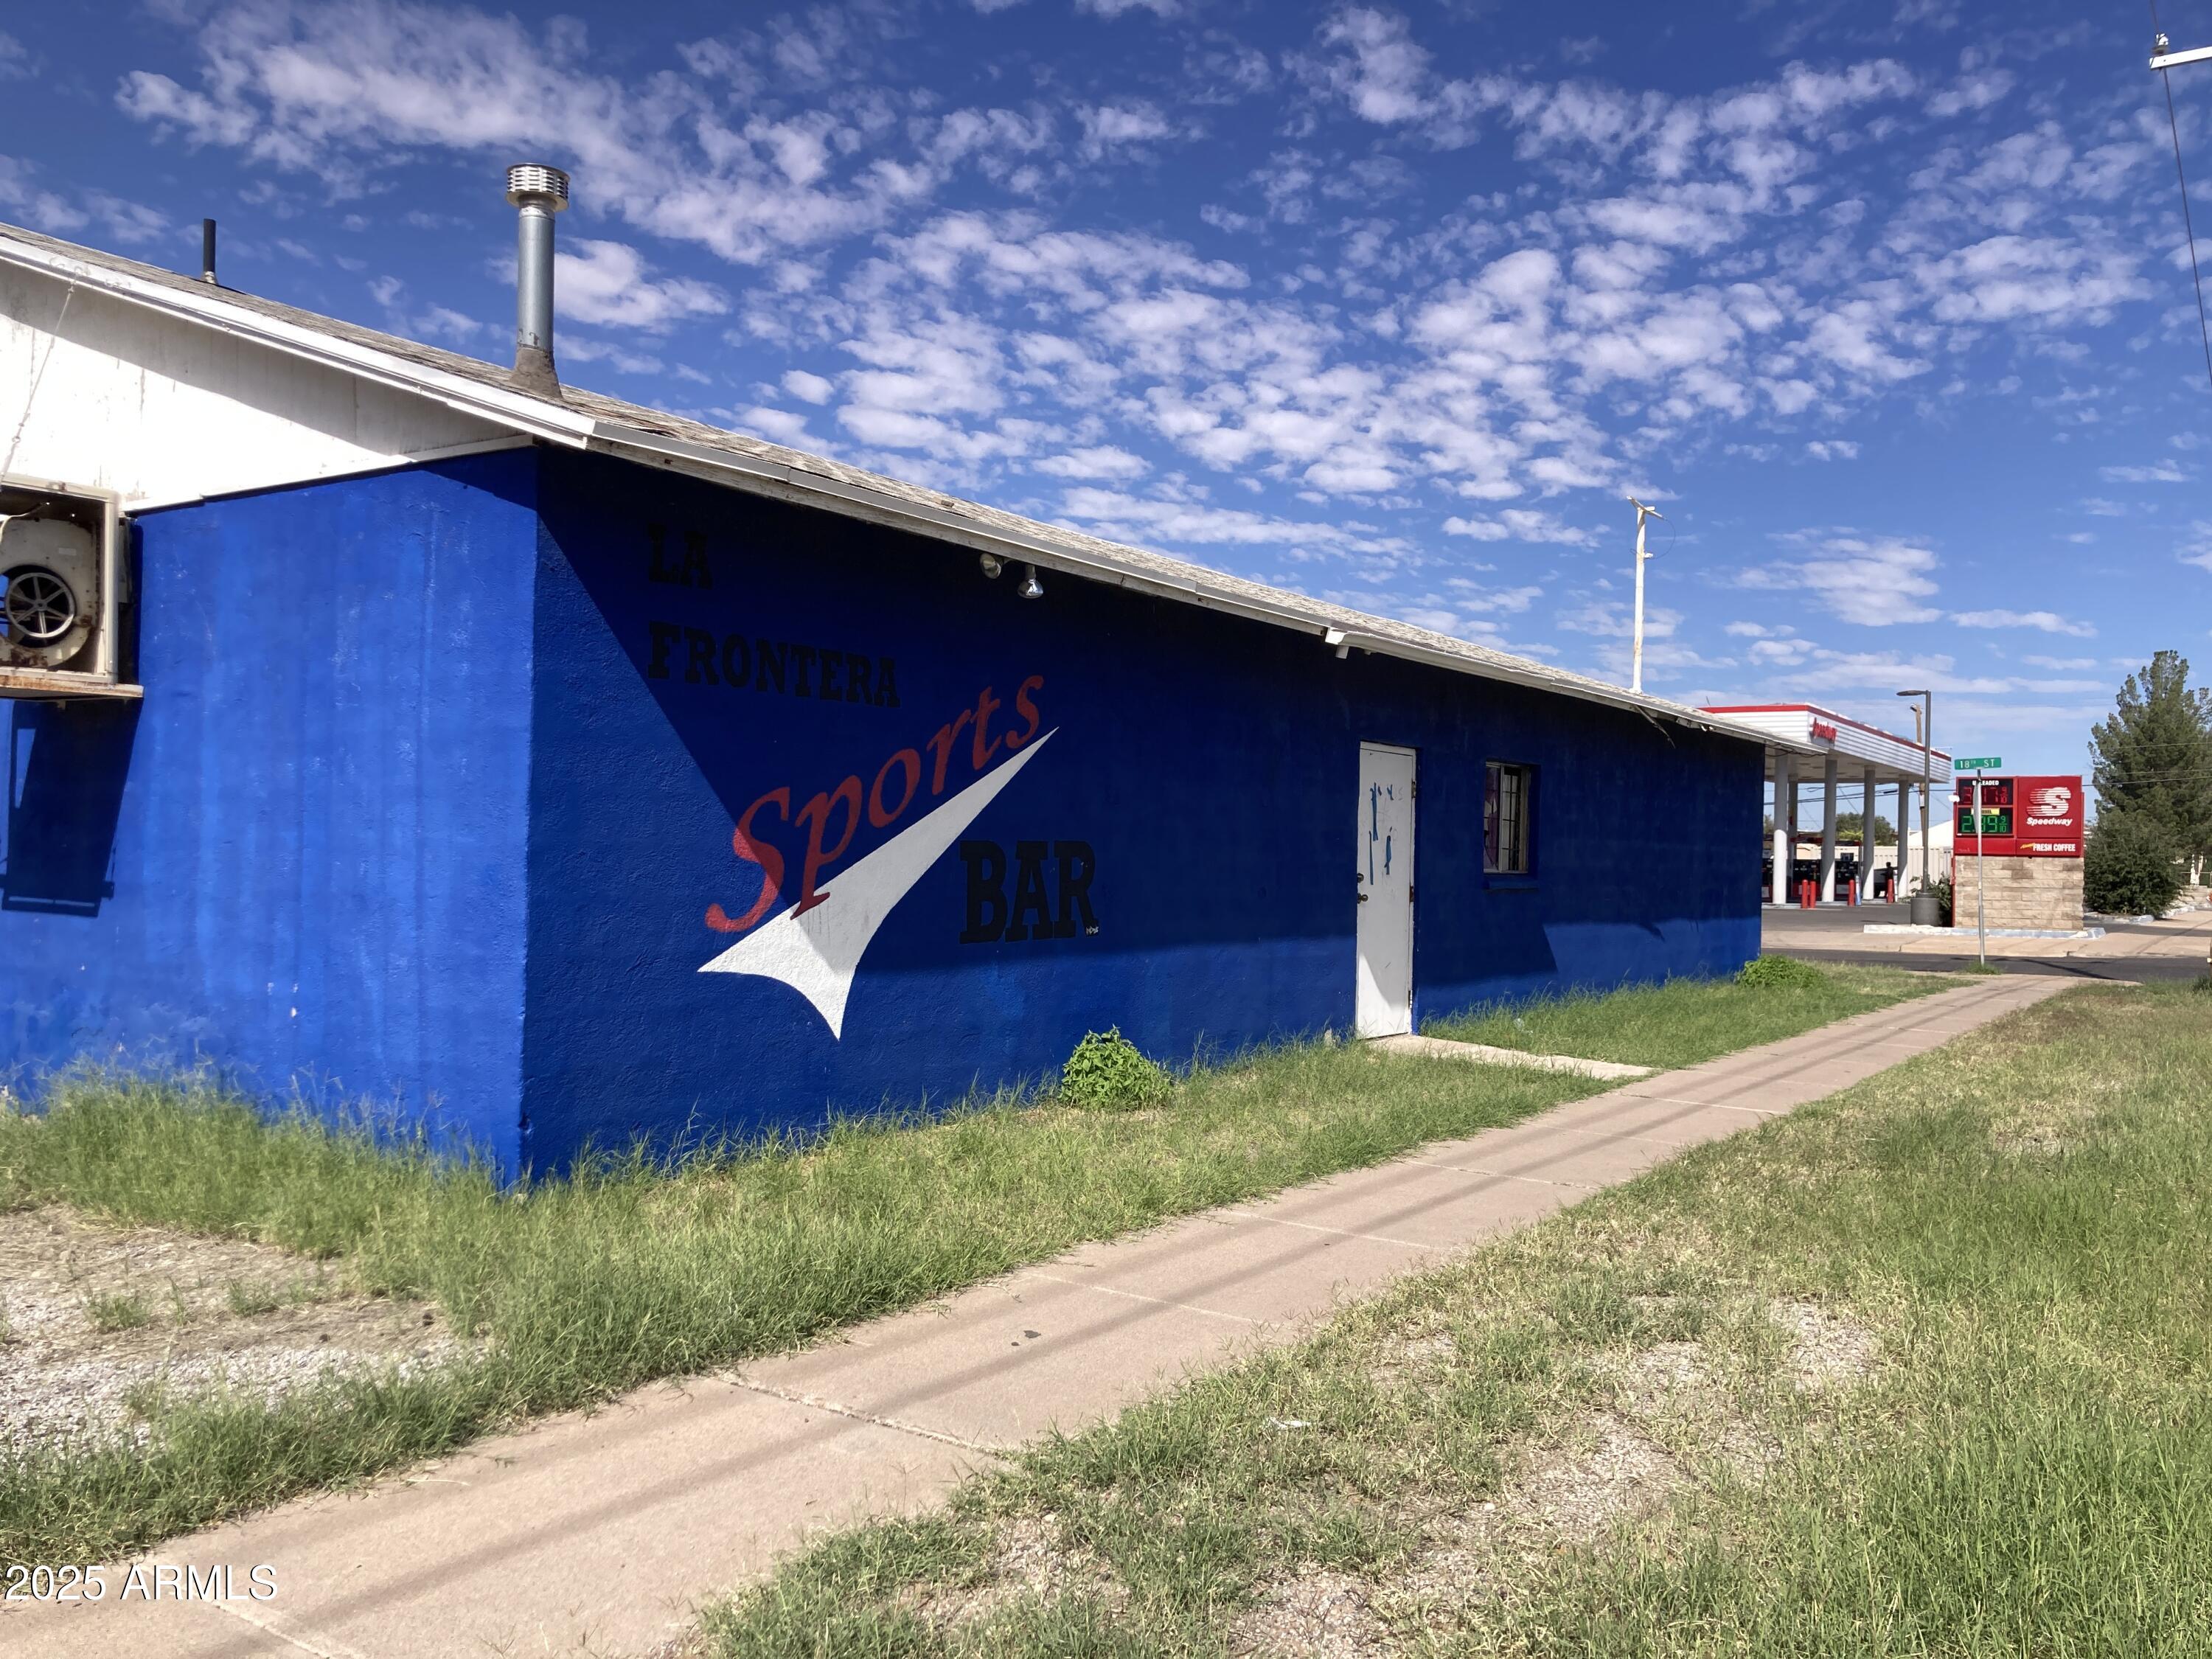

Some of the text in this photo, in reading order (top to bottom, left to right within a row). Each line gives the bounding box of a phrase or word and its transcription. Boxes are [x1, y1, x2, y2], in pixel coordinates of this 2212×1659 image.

[648, 523, 713, 590] LA
[647, 621, 900, 708] FRONTERA
[1983, 759, 1994, 768] ST
[705, 675, 1045, 933] Sports
[2026, 817, 2073, 827] Speedway
[2033, 843, 2076, 852] FRESH COFFEE
[959, 840, 1099, 945] BAR
